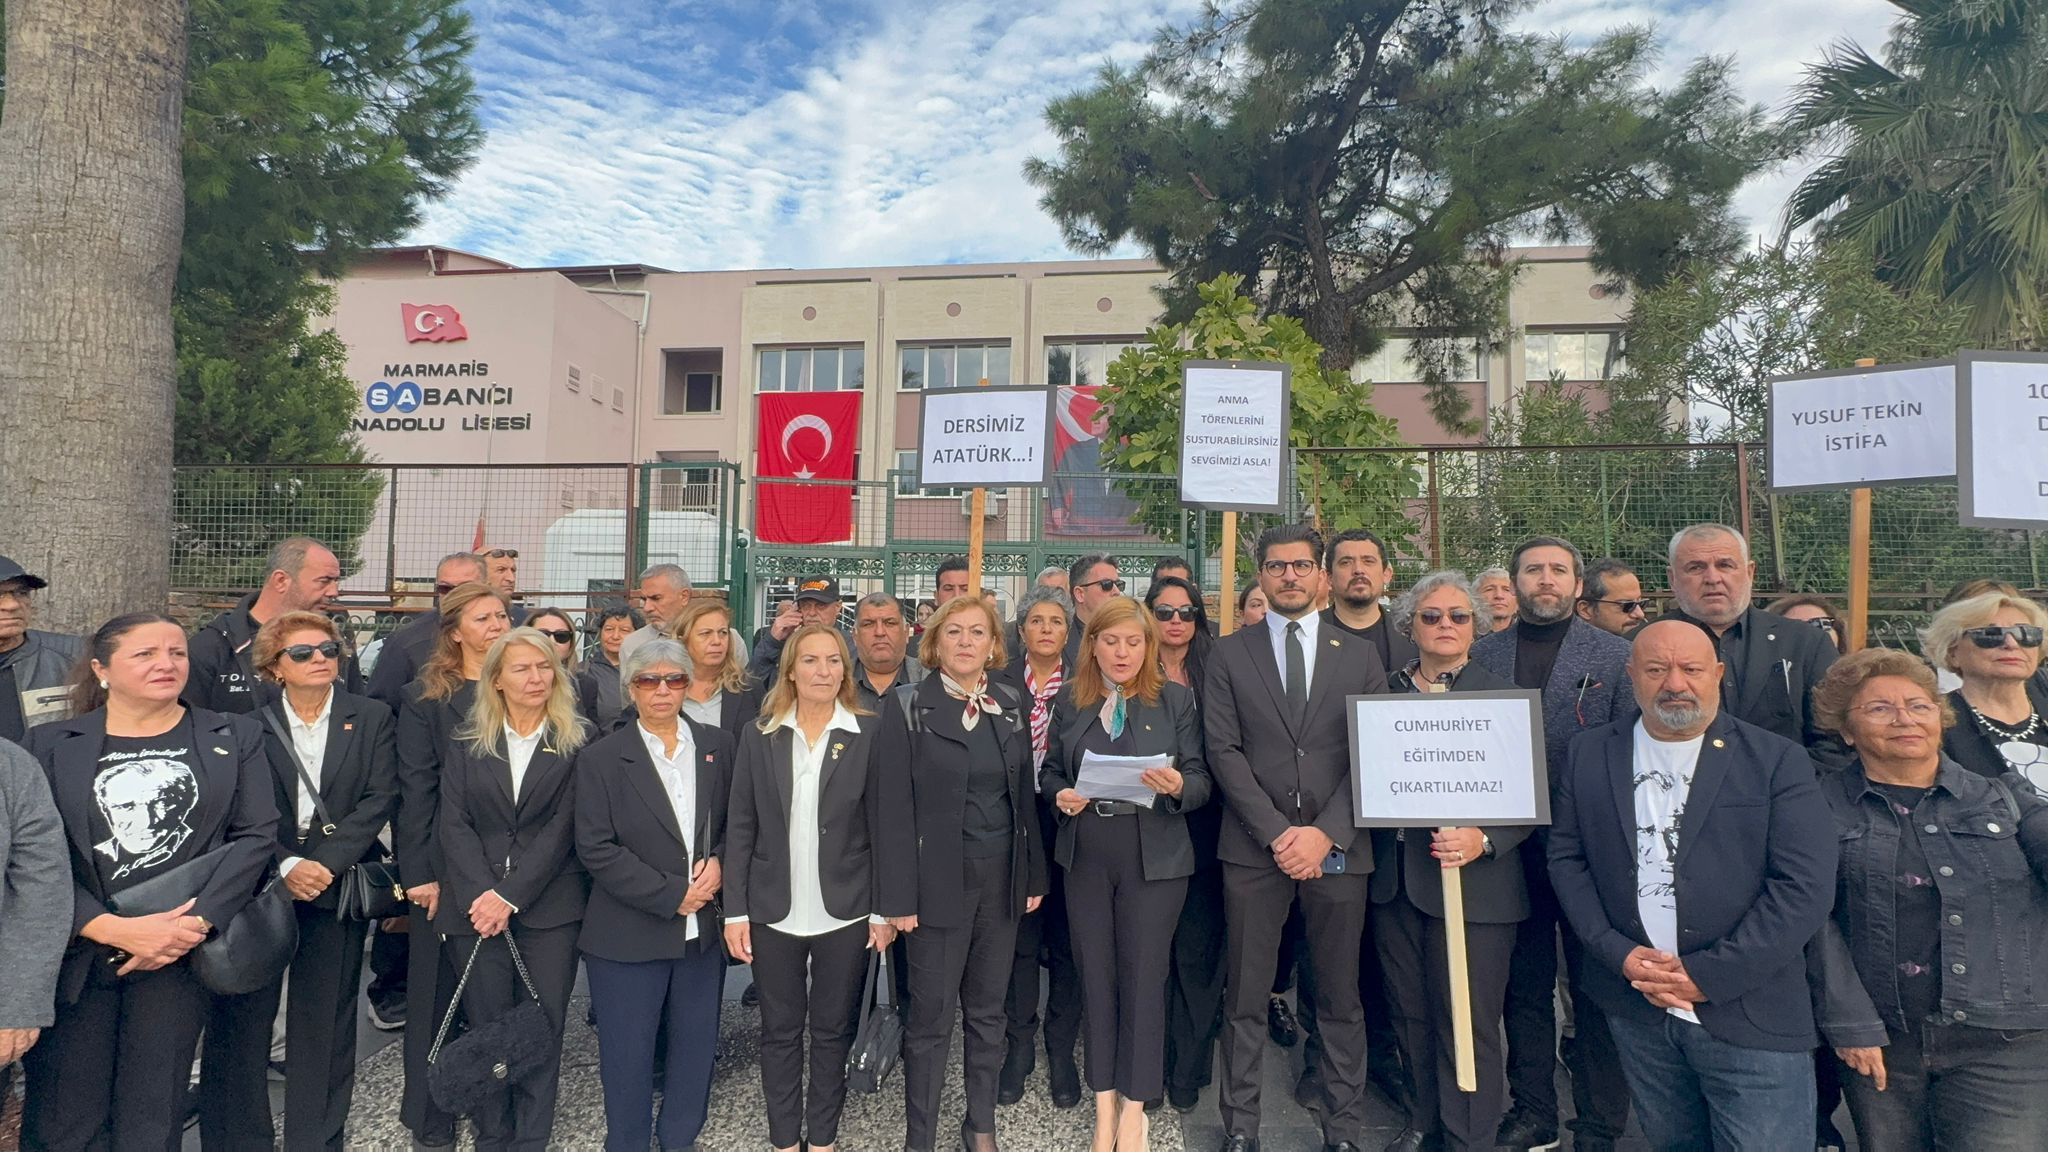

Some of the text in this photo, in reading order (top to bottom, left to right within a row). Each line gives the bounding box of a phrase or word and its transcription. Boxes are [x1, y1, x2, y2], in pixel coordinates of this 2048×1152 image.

[384, 360, 489, 377] MARMARİS
[371, 387, 513, 406] SABANCI
[1217, 395, 1249, 405] ANMA
[1201, 414, 1265, 426] TÖRENLERİNİ
[1792, 400, 1922, 426] YUSUF TEKİN
[352, 413, 531, 432] NADOLU LİSESİ
[944, 413, 1025, 434] DERSİMİZ
[1186, 435, 1279, 447] SUSTURABİLİRSİNİZ
[1826, 433, 1888, 452] İSTİFA
[933, 444, 1033, 464] ATATÜRK...!
[1191, 455, 1271, 467] SEVGİMİZİ ASLA!
[1394, 717, 1492, 732] CUMHURİYET
[1404, 747, 1486, 762] EĞİTİMDEN
[1390, 781, 1503, 796] ÇIKARTILAMAZ!
